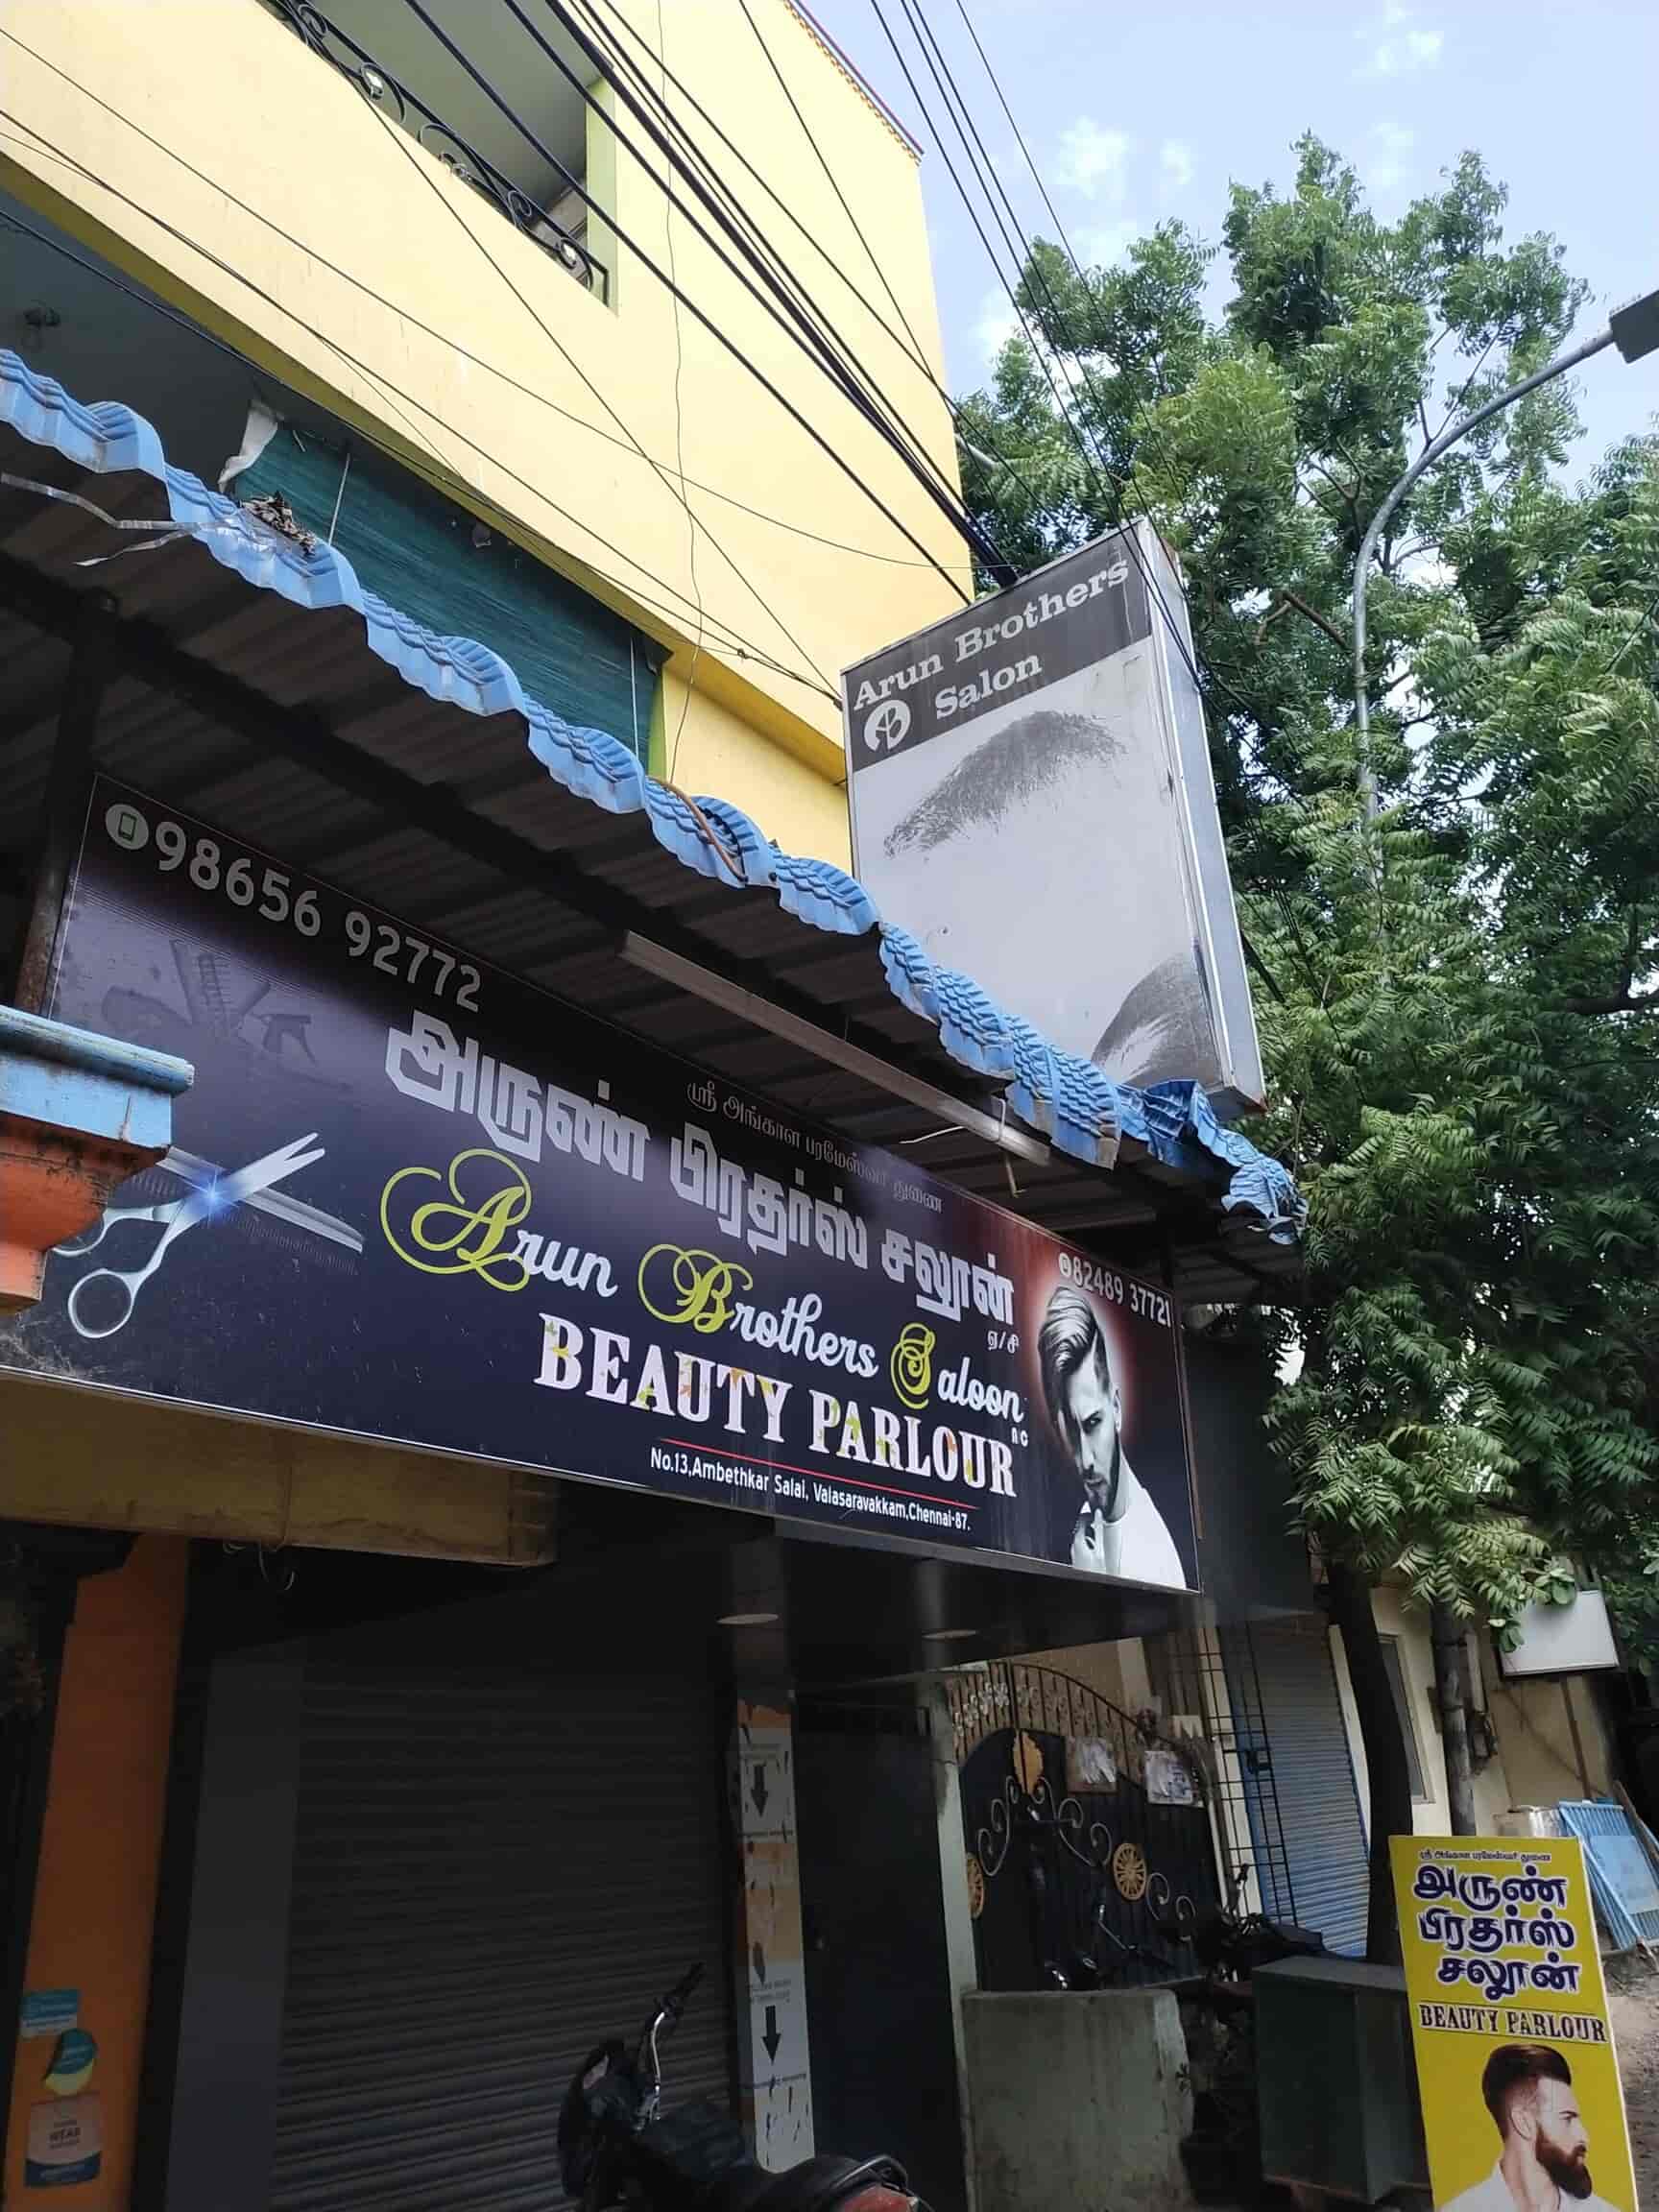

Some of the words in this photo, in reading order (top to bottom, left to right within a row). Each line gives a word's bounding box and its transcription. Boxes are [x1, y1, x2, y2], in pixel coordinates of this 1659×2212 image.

[854, 654, 944, 710] Arun
[954, 560, 1130, 663] Brothers
[935, 655, 1043, 720] Salon
[155, 821, 322, 936] 98656
[345, 911, 482, 1013] 92772
[380, 1148, 619, 1298] Arun
[638, 1244, 879, 1379] Brothers
[1072, 1256, 1124, 1305] 82489
[1129, 1283, 1171, 1329] 37721
[534, 1312, 793, 1443] BEAUTY
[808, 1388, 1018, 1498] PARLOUR
[1414, 1864, 1567, 1911] அருண்
[1437, 1951, 1581, 2001] சலூன்
[1419, 2004, 1499, 2033] BEAUTY
[1505, 2010, 1607, 2043] PARLOUR
